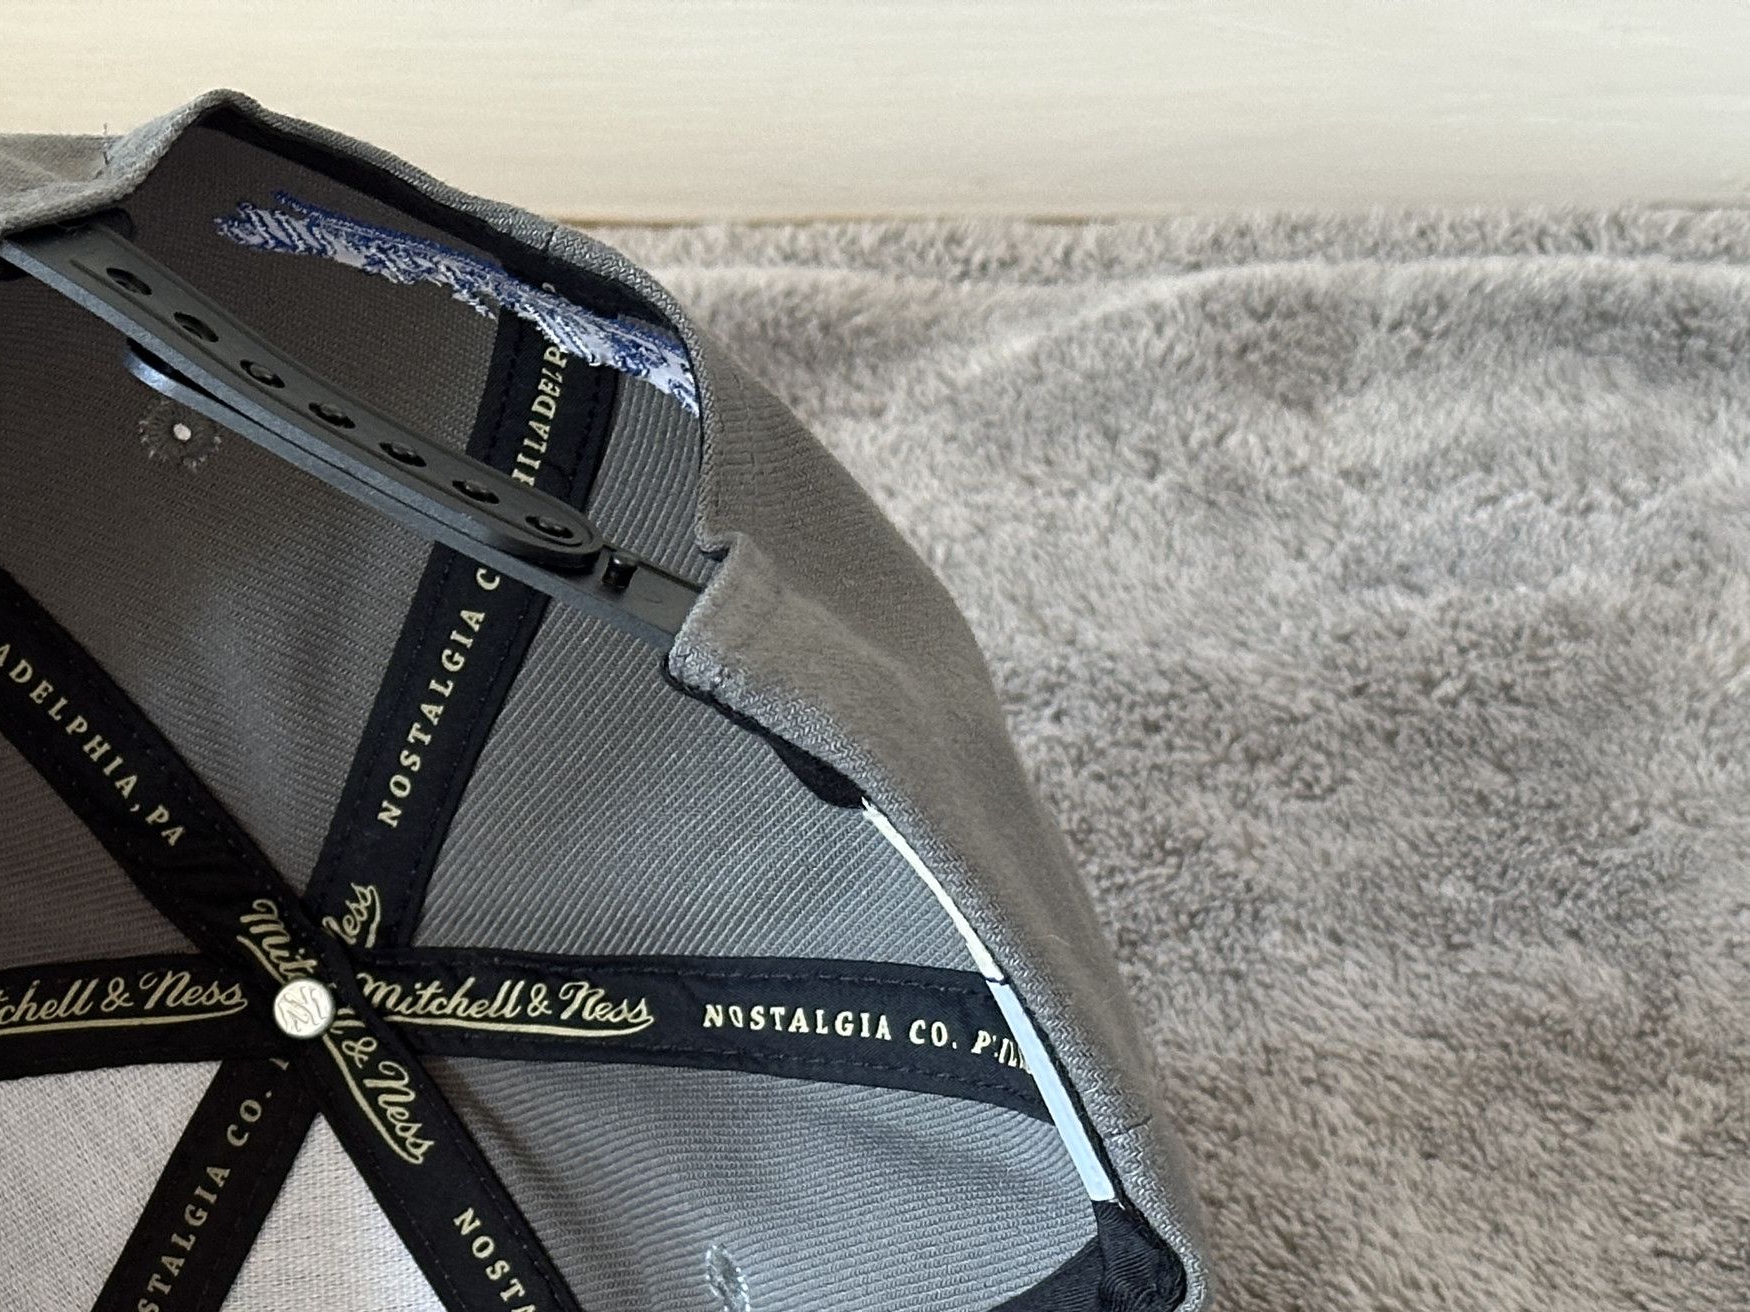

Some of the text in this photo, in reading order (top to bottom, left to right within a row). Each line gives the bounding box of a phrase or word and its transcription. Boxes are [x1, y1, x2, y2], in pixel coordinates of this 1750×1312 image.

[377, 606, 486, 828] NOSTALGIA
[100, 976, 132, 1012] &
[139, 970, 247, 1010] Ness
[356, 973, 526, 1018] Mitchell
[526, 982, 552, 1016] &
[558, 981, 655, 1024] Ness
[702, 1003, 958, 1051] NOSTALGIA CO.
[226, 1090, 272, 1147] CO.
[341, 1036, 378, 1068] &
[362, 1060, 435, 1164] Ness
